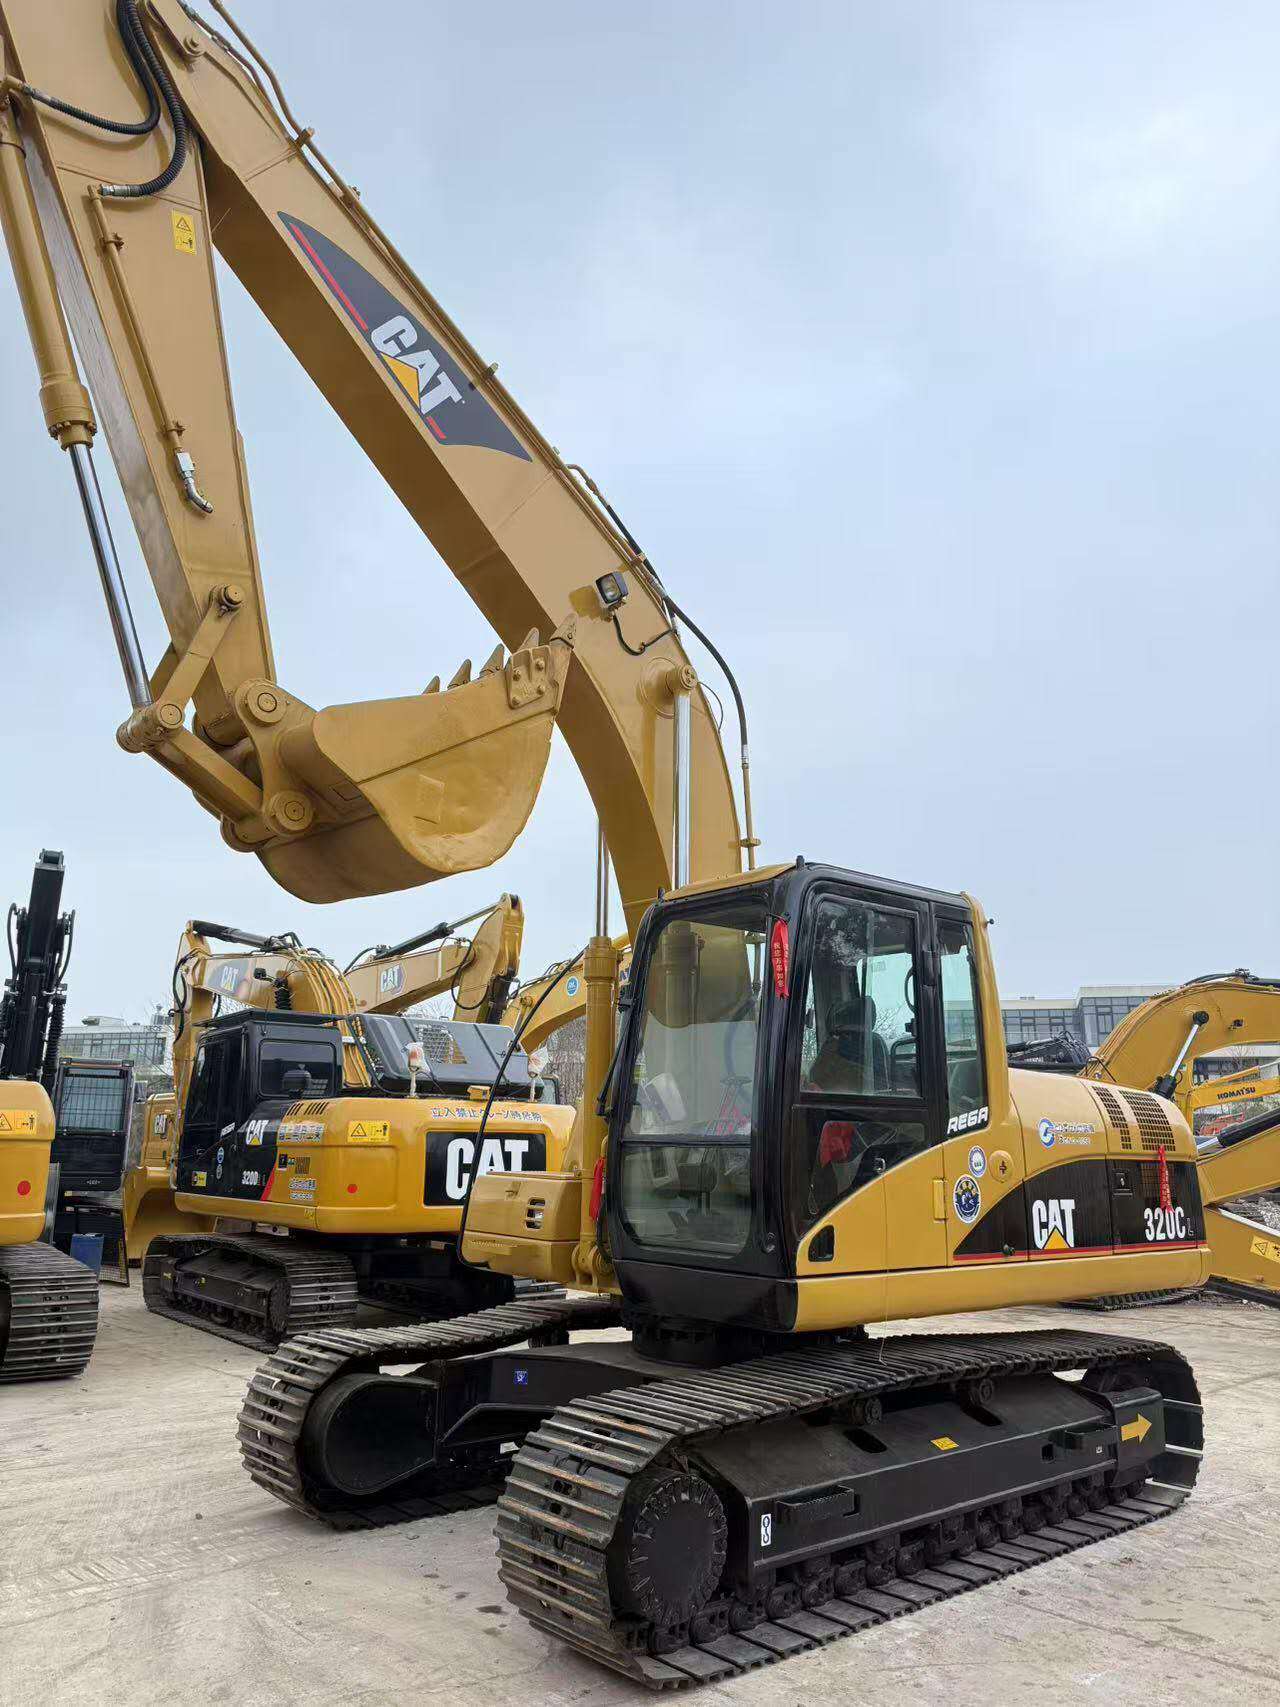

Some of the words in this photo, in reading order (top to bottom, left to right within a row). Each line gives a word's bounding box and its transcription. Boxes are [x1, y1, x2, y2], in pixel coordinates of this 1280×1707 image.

[371, 315, 462, 415] CAT
[221, 965, 239, 991] CAT
[380, 965, 400, 992] CAT
[1217, 1086, 1256, 1100] KOMATSU
[245, 1120, 269, 1145] CAT
[446, 1138, 529, 1200] CAT
[1032, 1199, 1076, 1250] CAT
[1144, 1206, 1186, 1241] 320C
